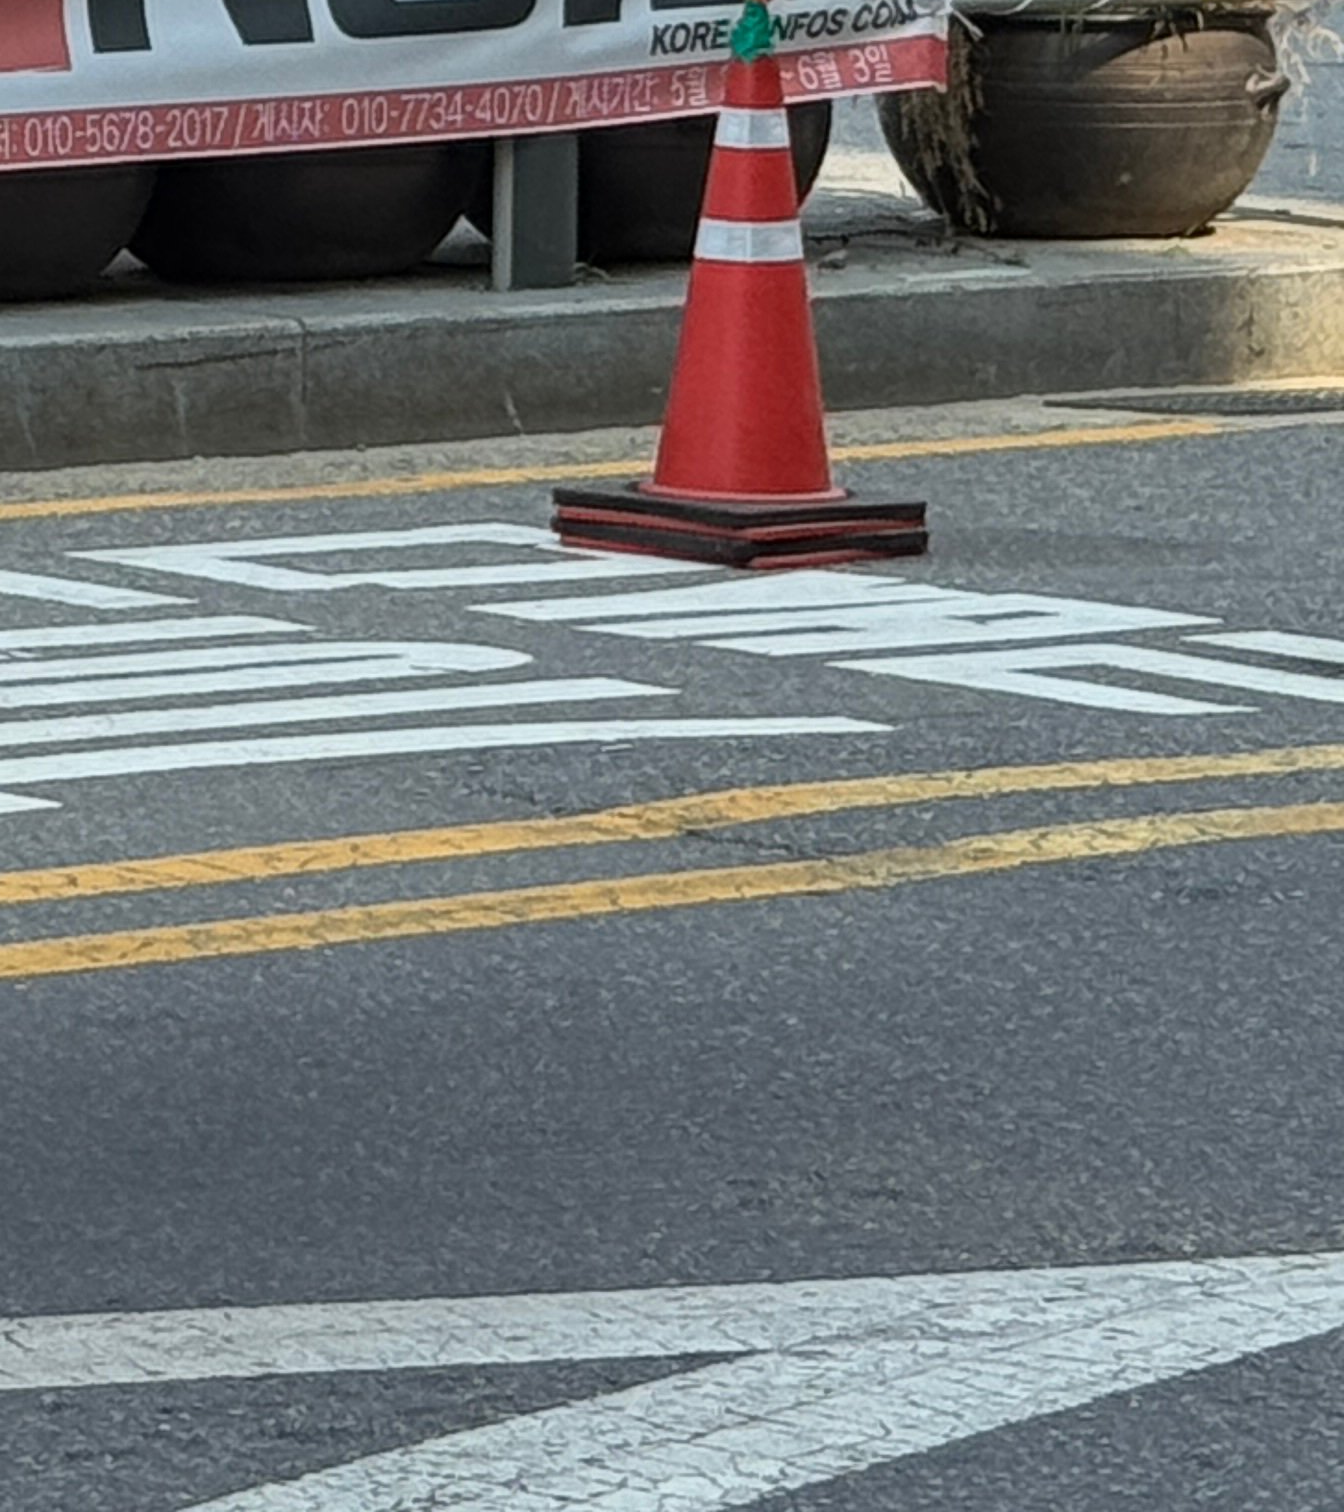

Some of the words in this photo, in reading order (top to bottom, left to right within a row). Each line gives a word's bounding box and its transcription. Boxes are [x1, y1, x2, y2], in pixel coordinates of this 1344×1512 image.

[849, 44, 895, 83] 3일
[23, 106, 230, 159] 010-5678-2017
[340, 82, 545, 136] 010-7734-4070
